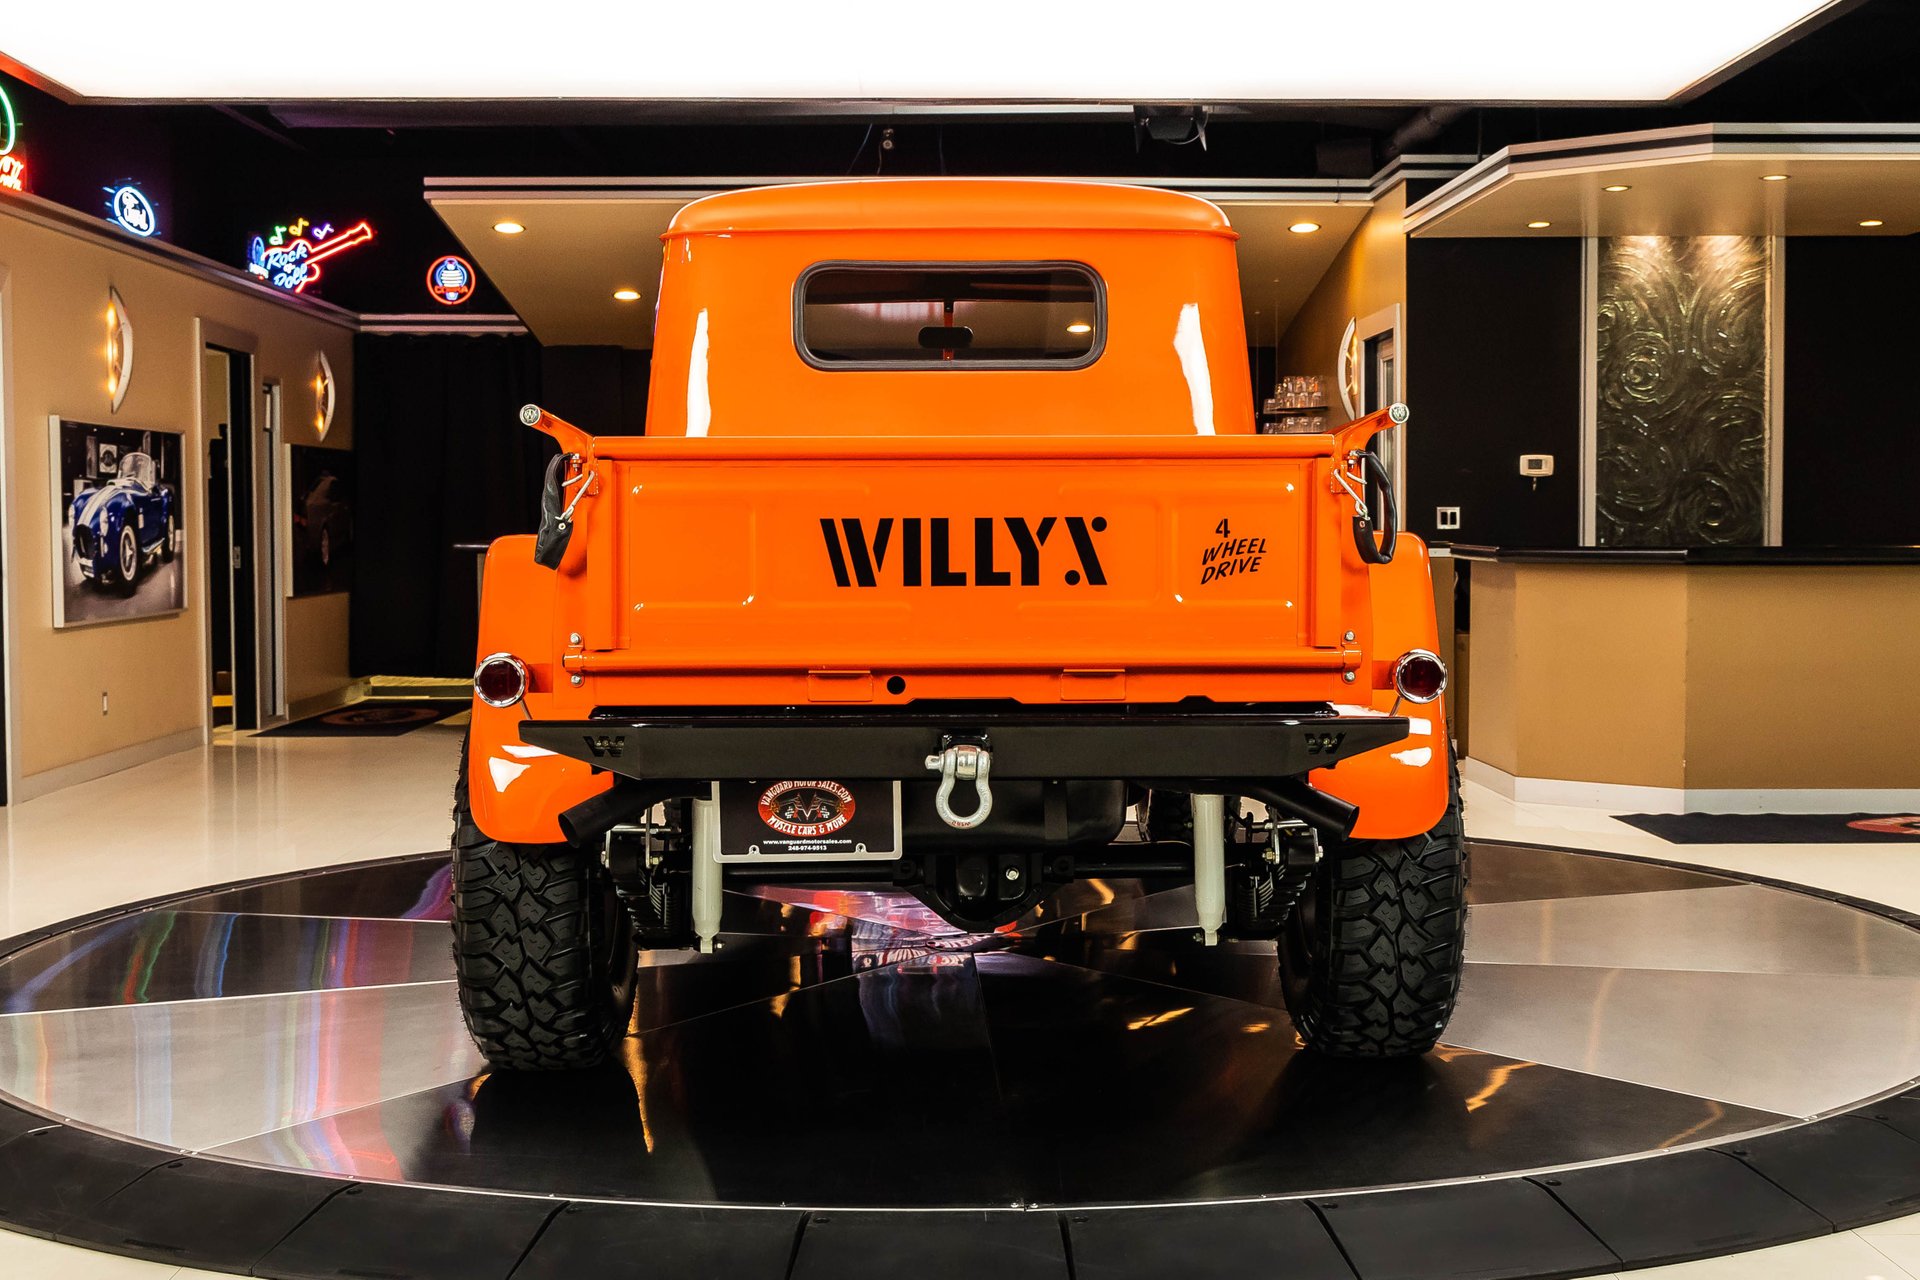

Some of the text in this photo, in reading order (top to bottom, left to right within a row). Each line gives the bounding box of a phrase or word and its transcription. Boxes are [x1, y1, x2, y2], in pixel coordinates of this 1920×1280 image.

[266, 242, 308, 270] Rock
[1215, 518, 1231, 538] 4
[1202, 538, 1267, 566] WHEEL
[1200, 556, 1262, 585] DRIVE
[761, 781, 793, 806] VANGUARD
[817, 781, 852, 804] SALES.COM
[767, 814, 848, 835] MUSCLE CARS & MORE
